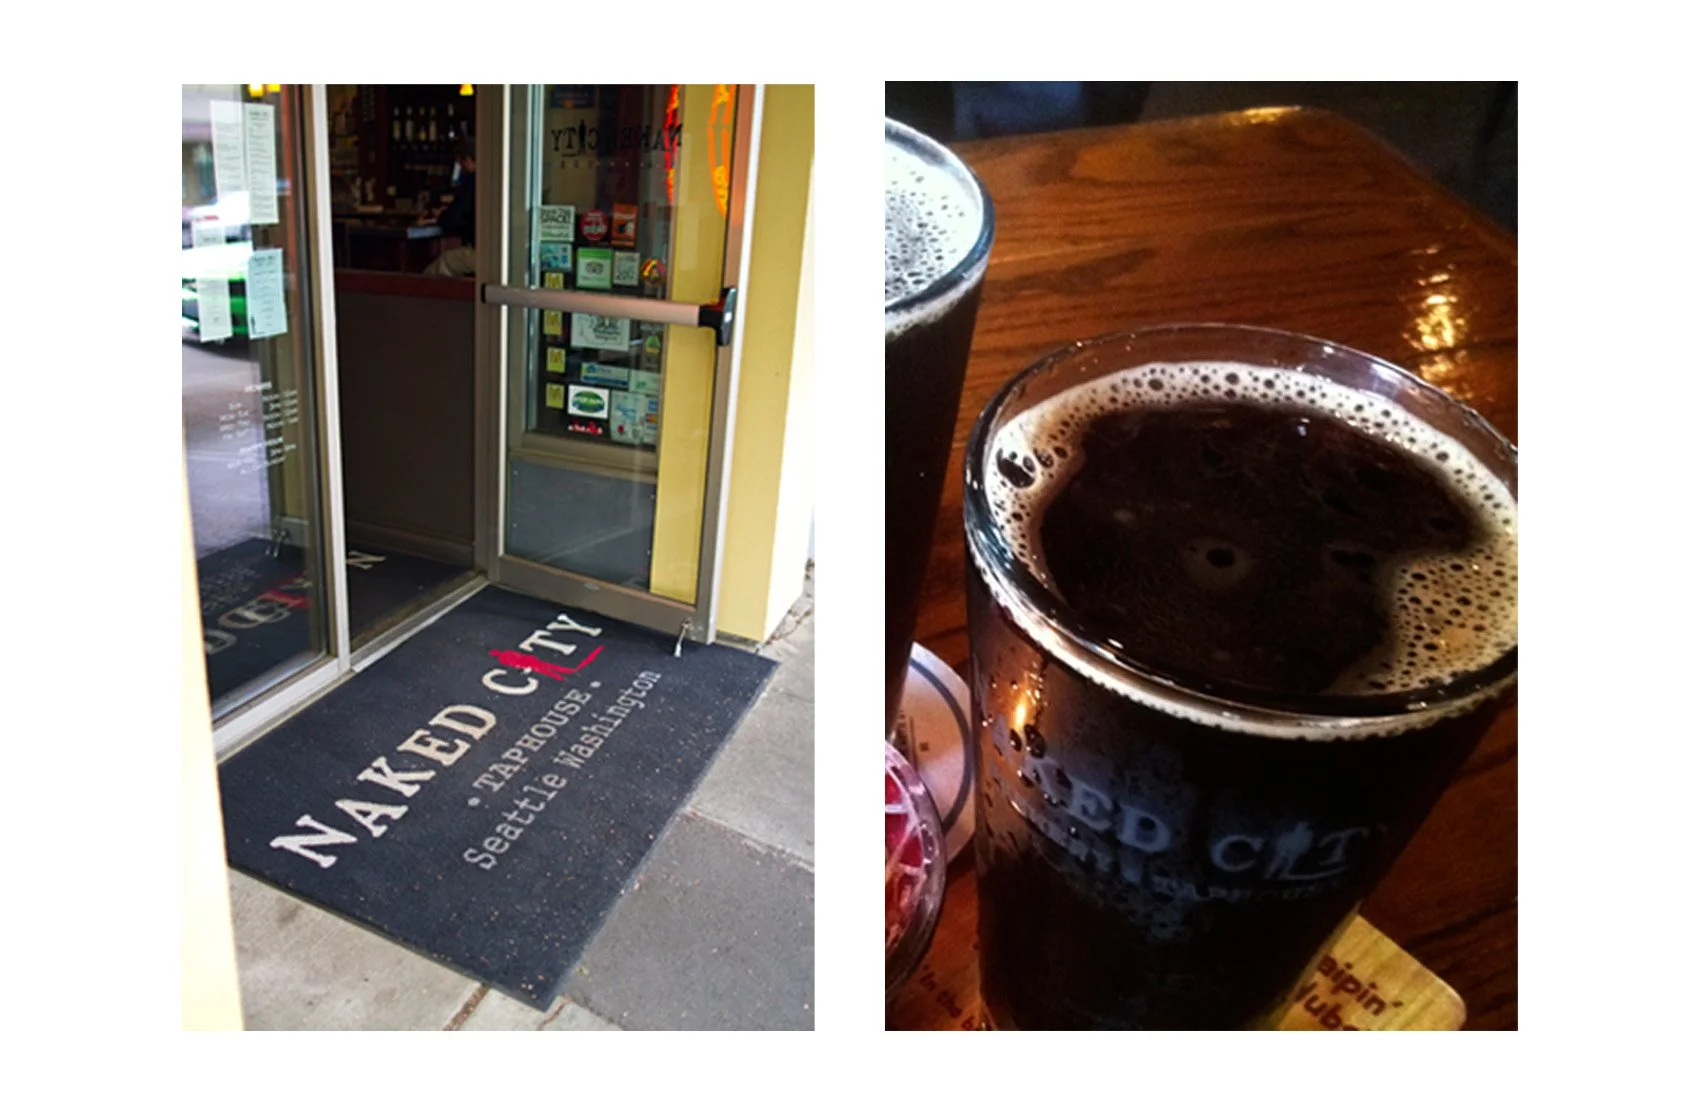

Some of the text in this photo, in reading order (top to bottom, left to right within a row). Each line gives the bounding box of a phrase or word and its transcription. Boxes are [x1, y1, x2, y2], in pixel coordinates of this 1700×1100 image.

[269, 613, 606, 869] NAKED CITY
[463, 669, 662, 871] Seattle Washington
[473, 688, 592, 796] TAPHOUSE
[1209, 820, 1376, 882] CIT
